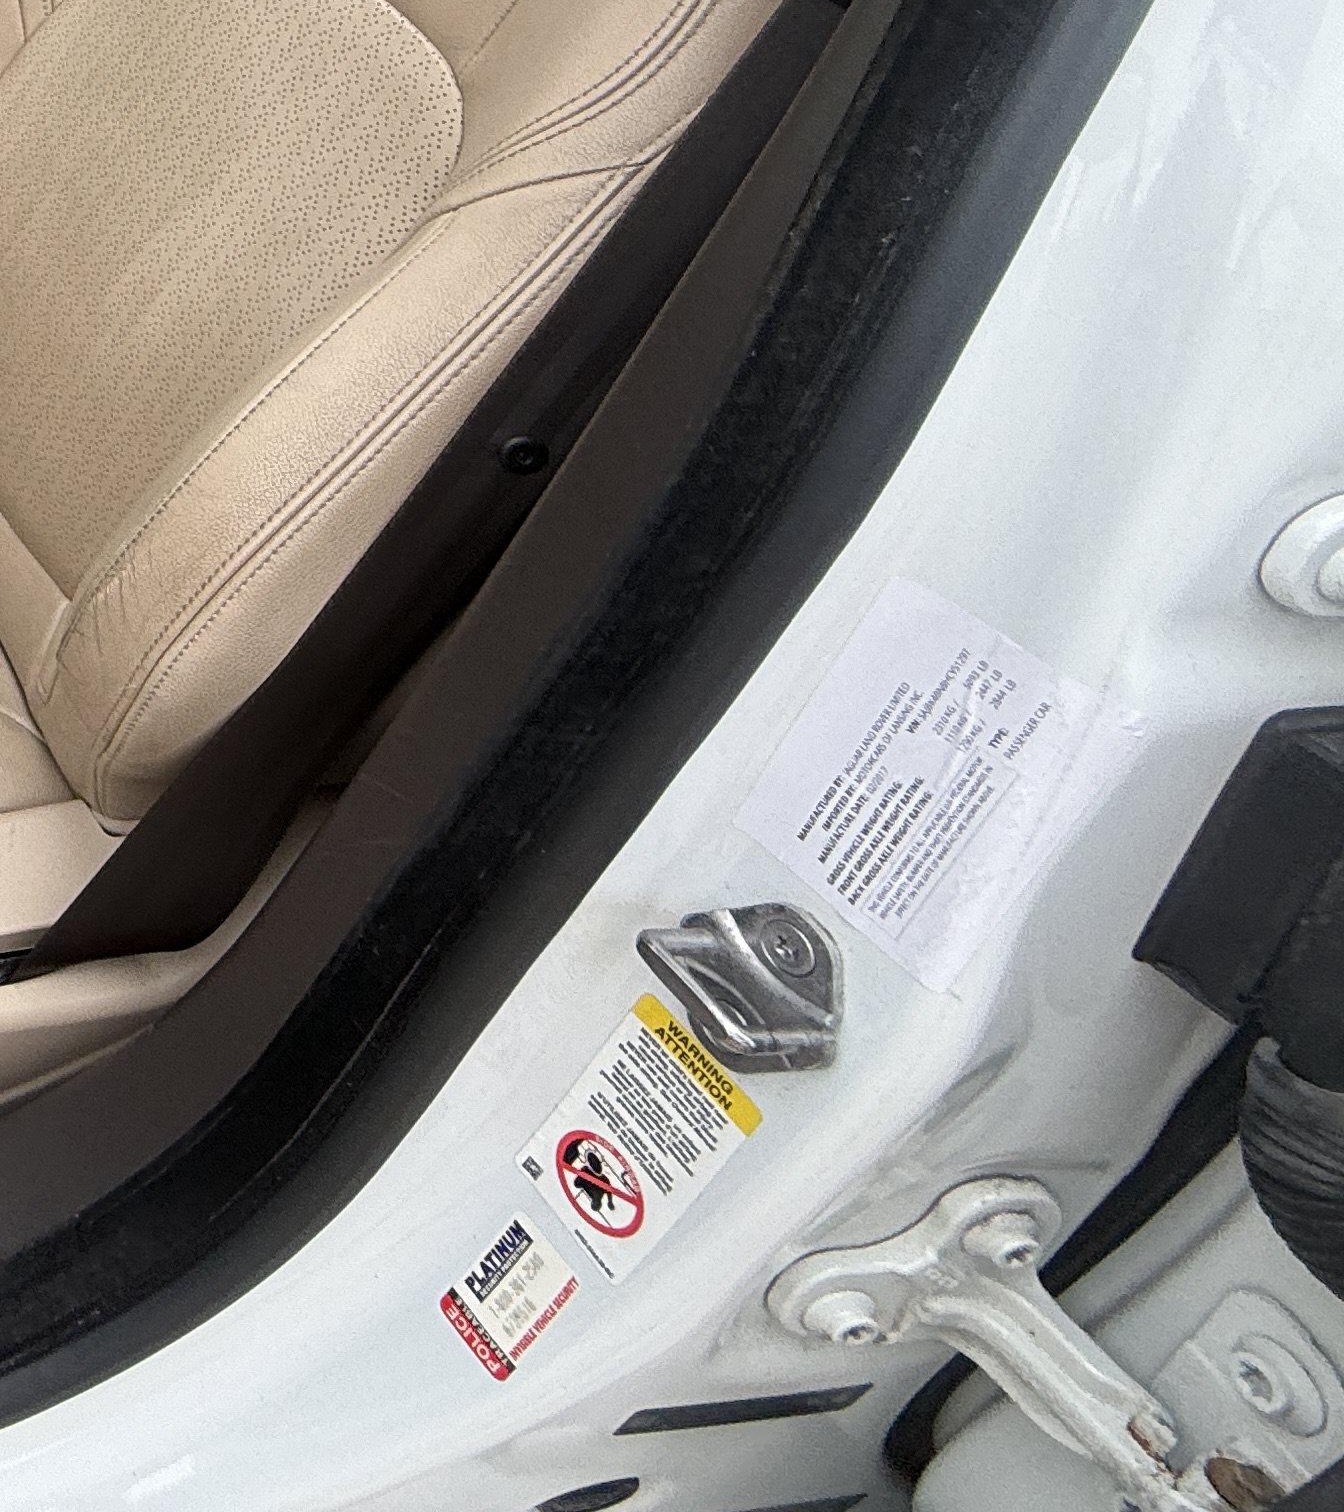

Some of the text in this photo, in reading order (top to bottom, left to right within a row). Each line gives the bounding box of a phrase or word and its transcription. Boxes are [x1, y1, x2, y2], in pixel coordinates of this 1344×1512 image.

[796, 785, 836, 840] MANUFACTURED
[654, 1026, 733, 1111] ATTENTION
[667, 1020, 733, 1096] WARNING
[465, 1219, 530, 1293] PLATINUM
[445, 1303, 501, 1374] POLICE
